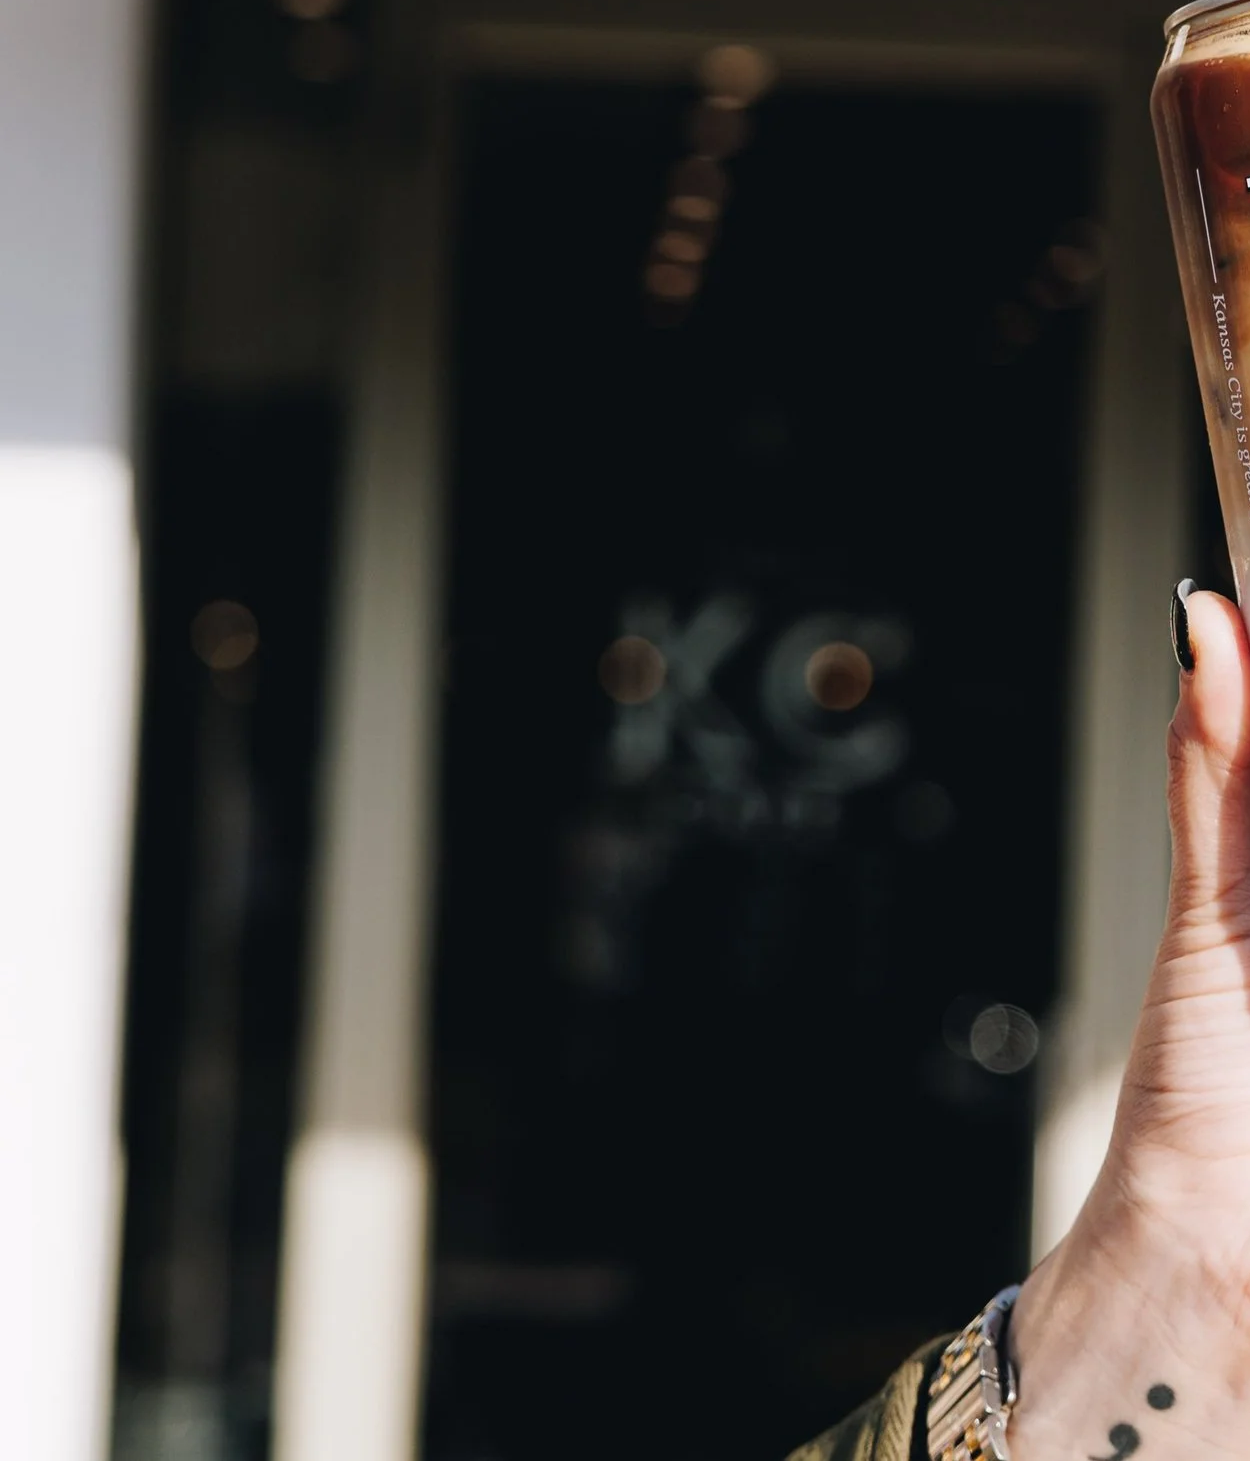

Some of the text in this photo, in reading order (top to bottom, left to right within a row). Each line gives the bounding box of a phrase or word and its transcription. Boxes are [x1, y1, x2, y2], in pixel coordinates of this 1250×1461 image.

[1211, 293, 1235, 372] Kansas
[1227, 376, 1244, 421] City
[1236, 426, 1249, 444] is
